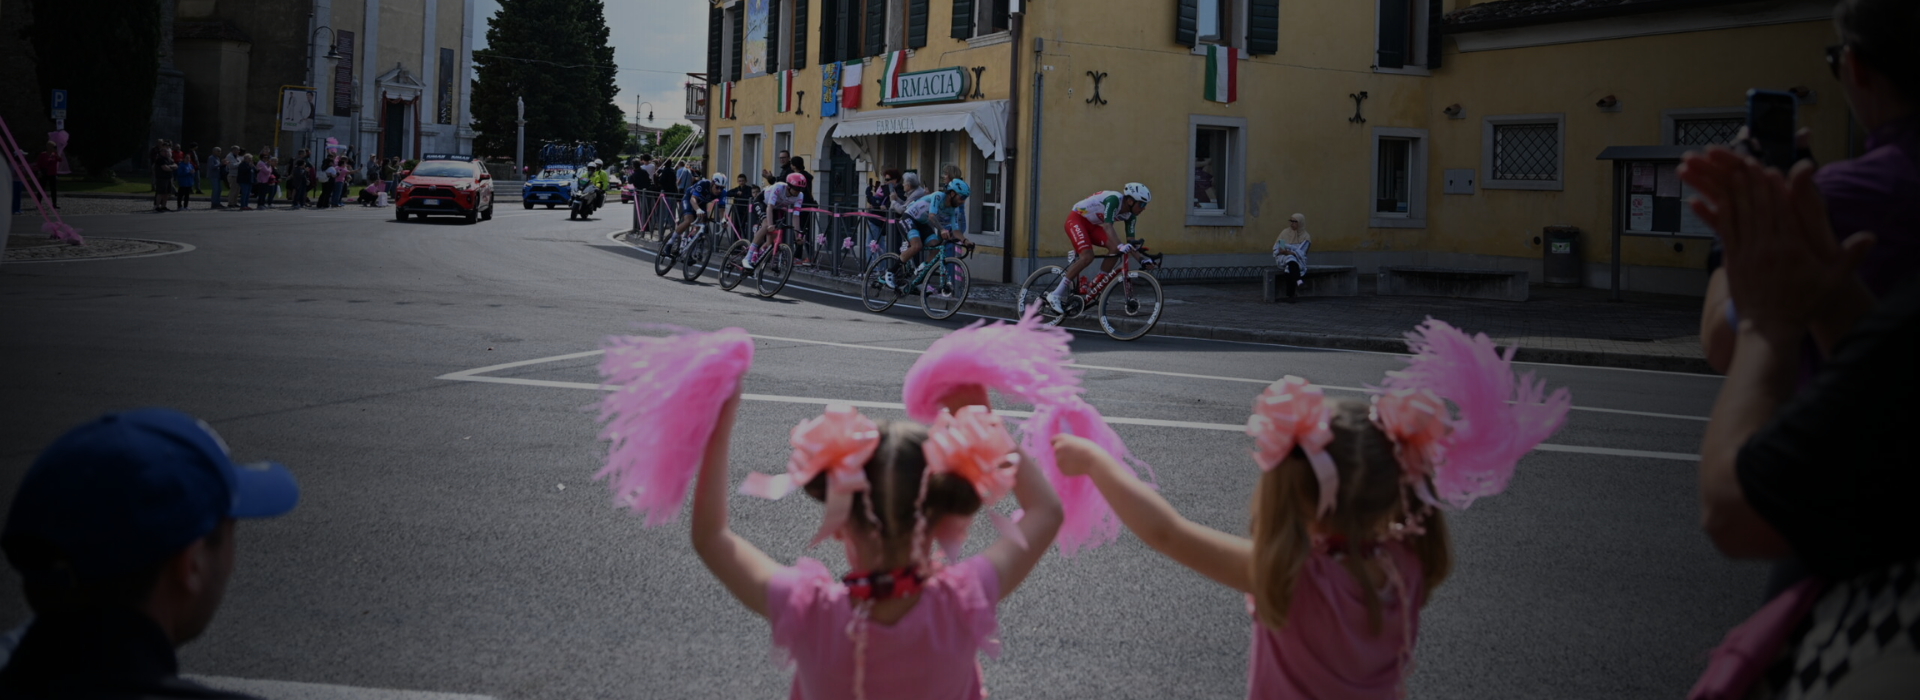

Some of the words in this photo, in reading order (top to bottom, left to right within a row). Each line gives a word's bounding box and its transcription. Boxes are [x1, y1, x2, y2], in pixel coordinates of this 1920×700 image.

[897, 74, 955, 98] RMACIA
[54, 92, 64, 107] P
[876, 117, 915, 132] FARMACIA
[1073, 224, 1085, 240] POLTI
[1084, 269, 1117, 302] AURUM
